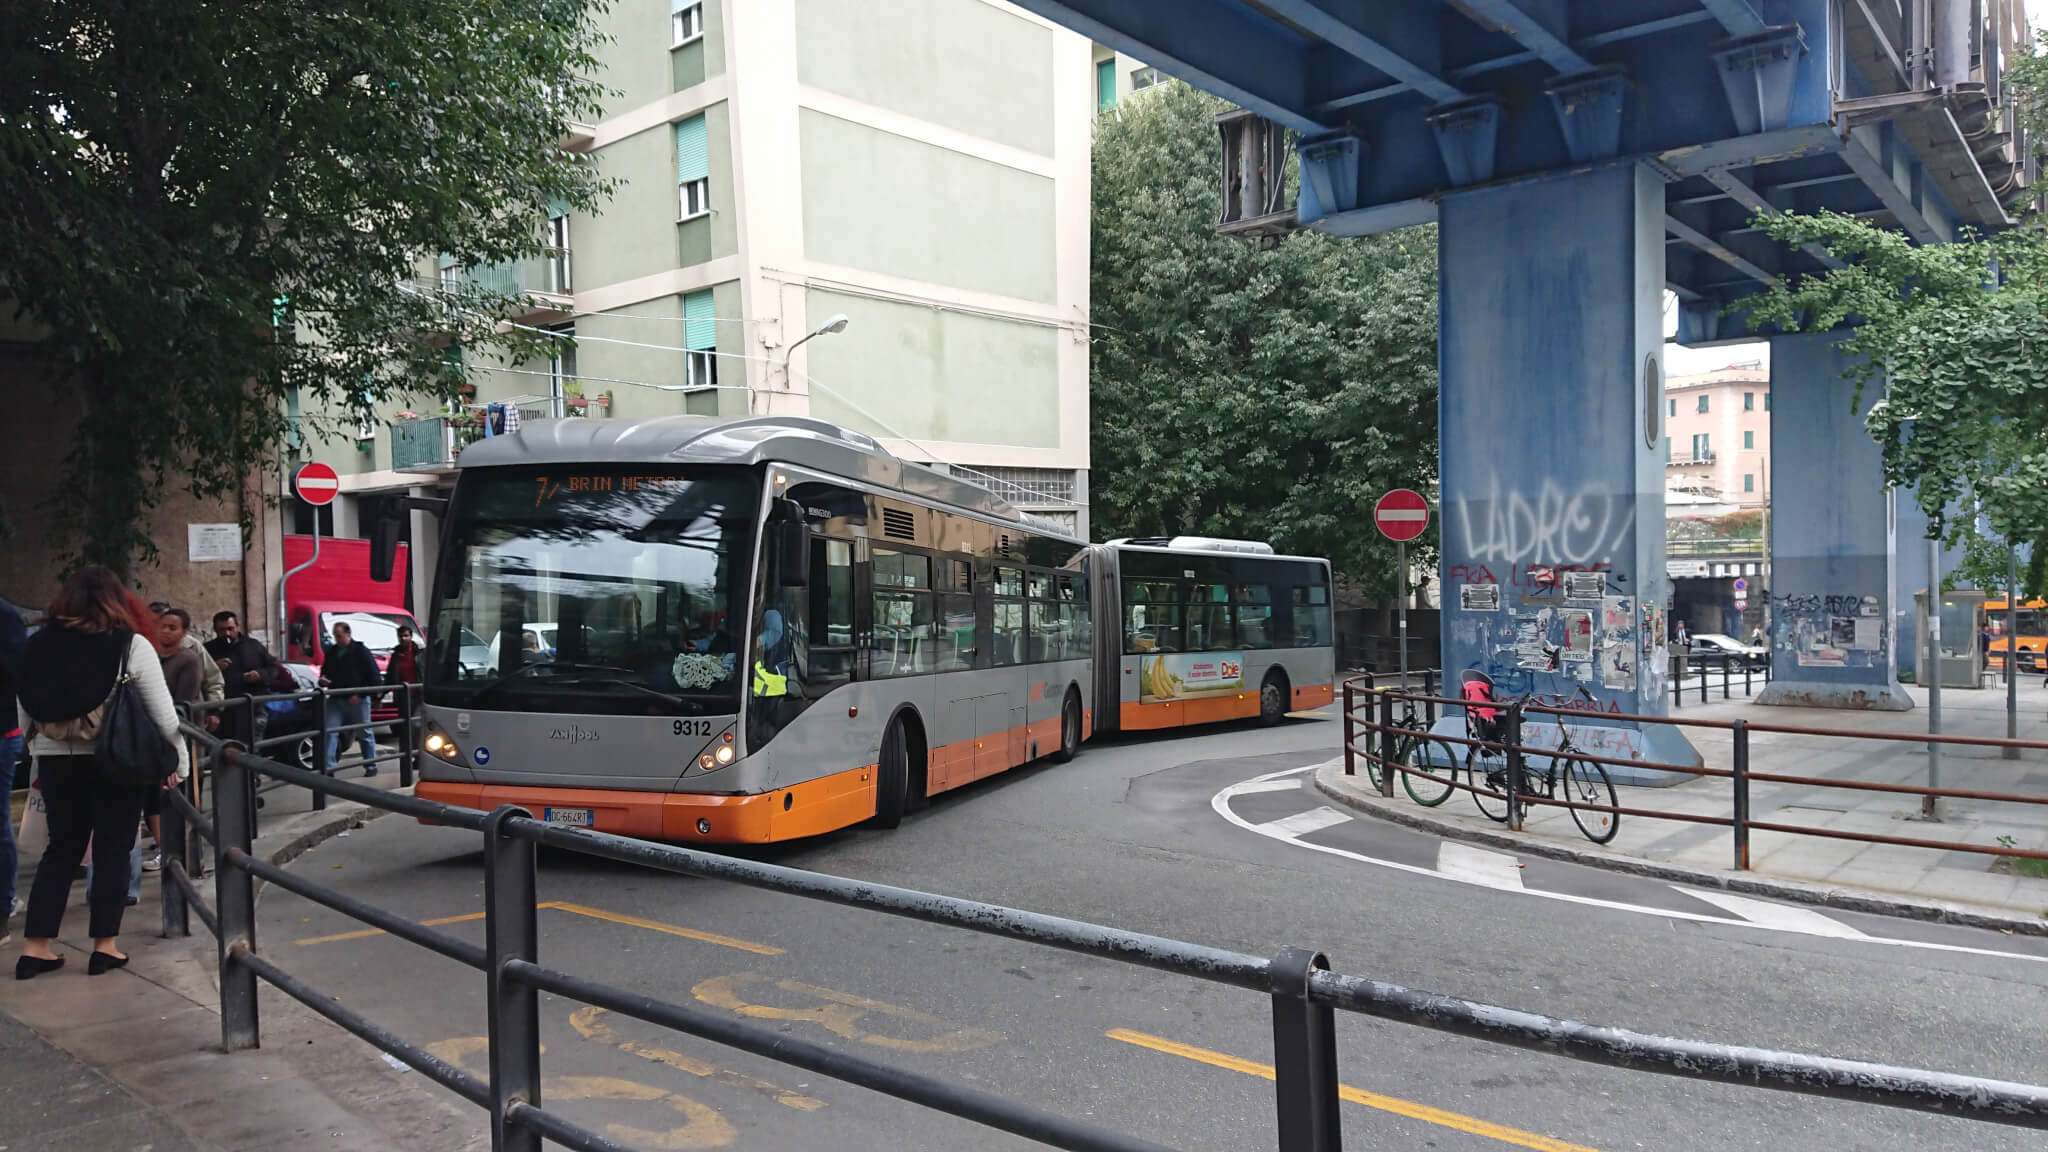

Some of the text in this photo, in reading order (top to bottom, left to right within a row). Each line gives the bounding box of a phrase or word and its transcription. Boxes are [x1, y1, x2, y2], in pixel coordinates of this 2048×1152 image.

[569, 475, 611, 491] BRIN
[1457, 471, 1635, 564] LADRO!
[673, 720, 711, 737] 9312
